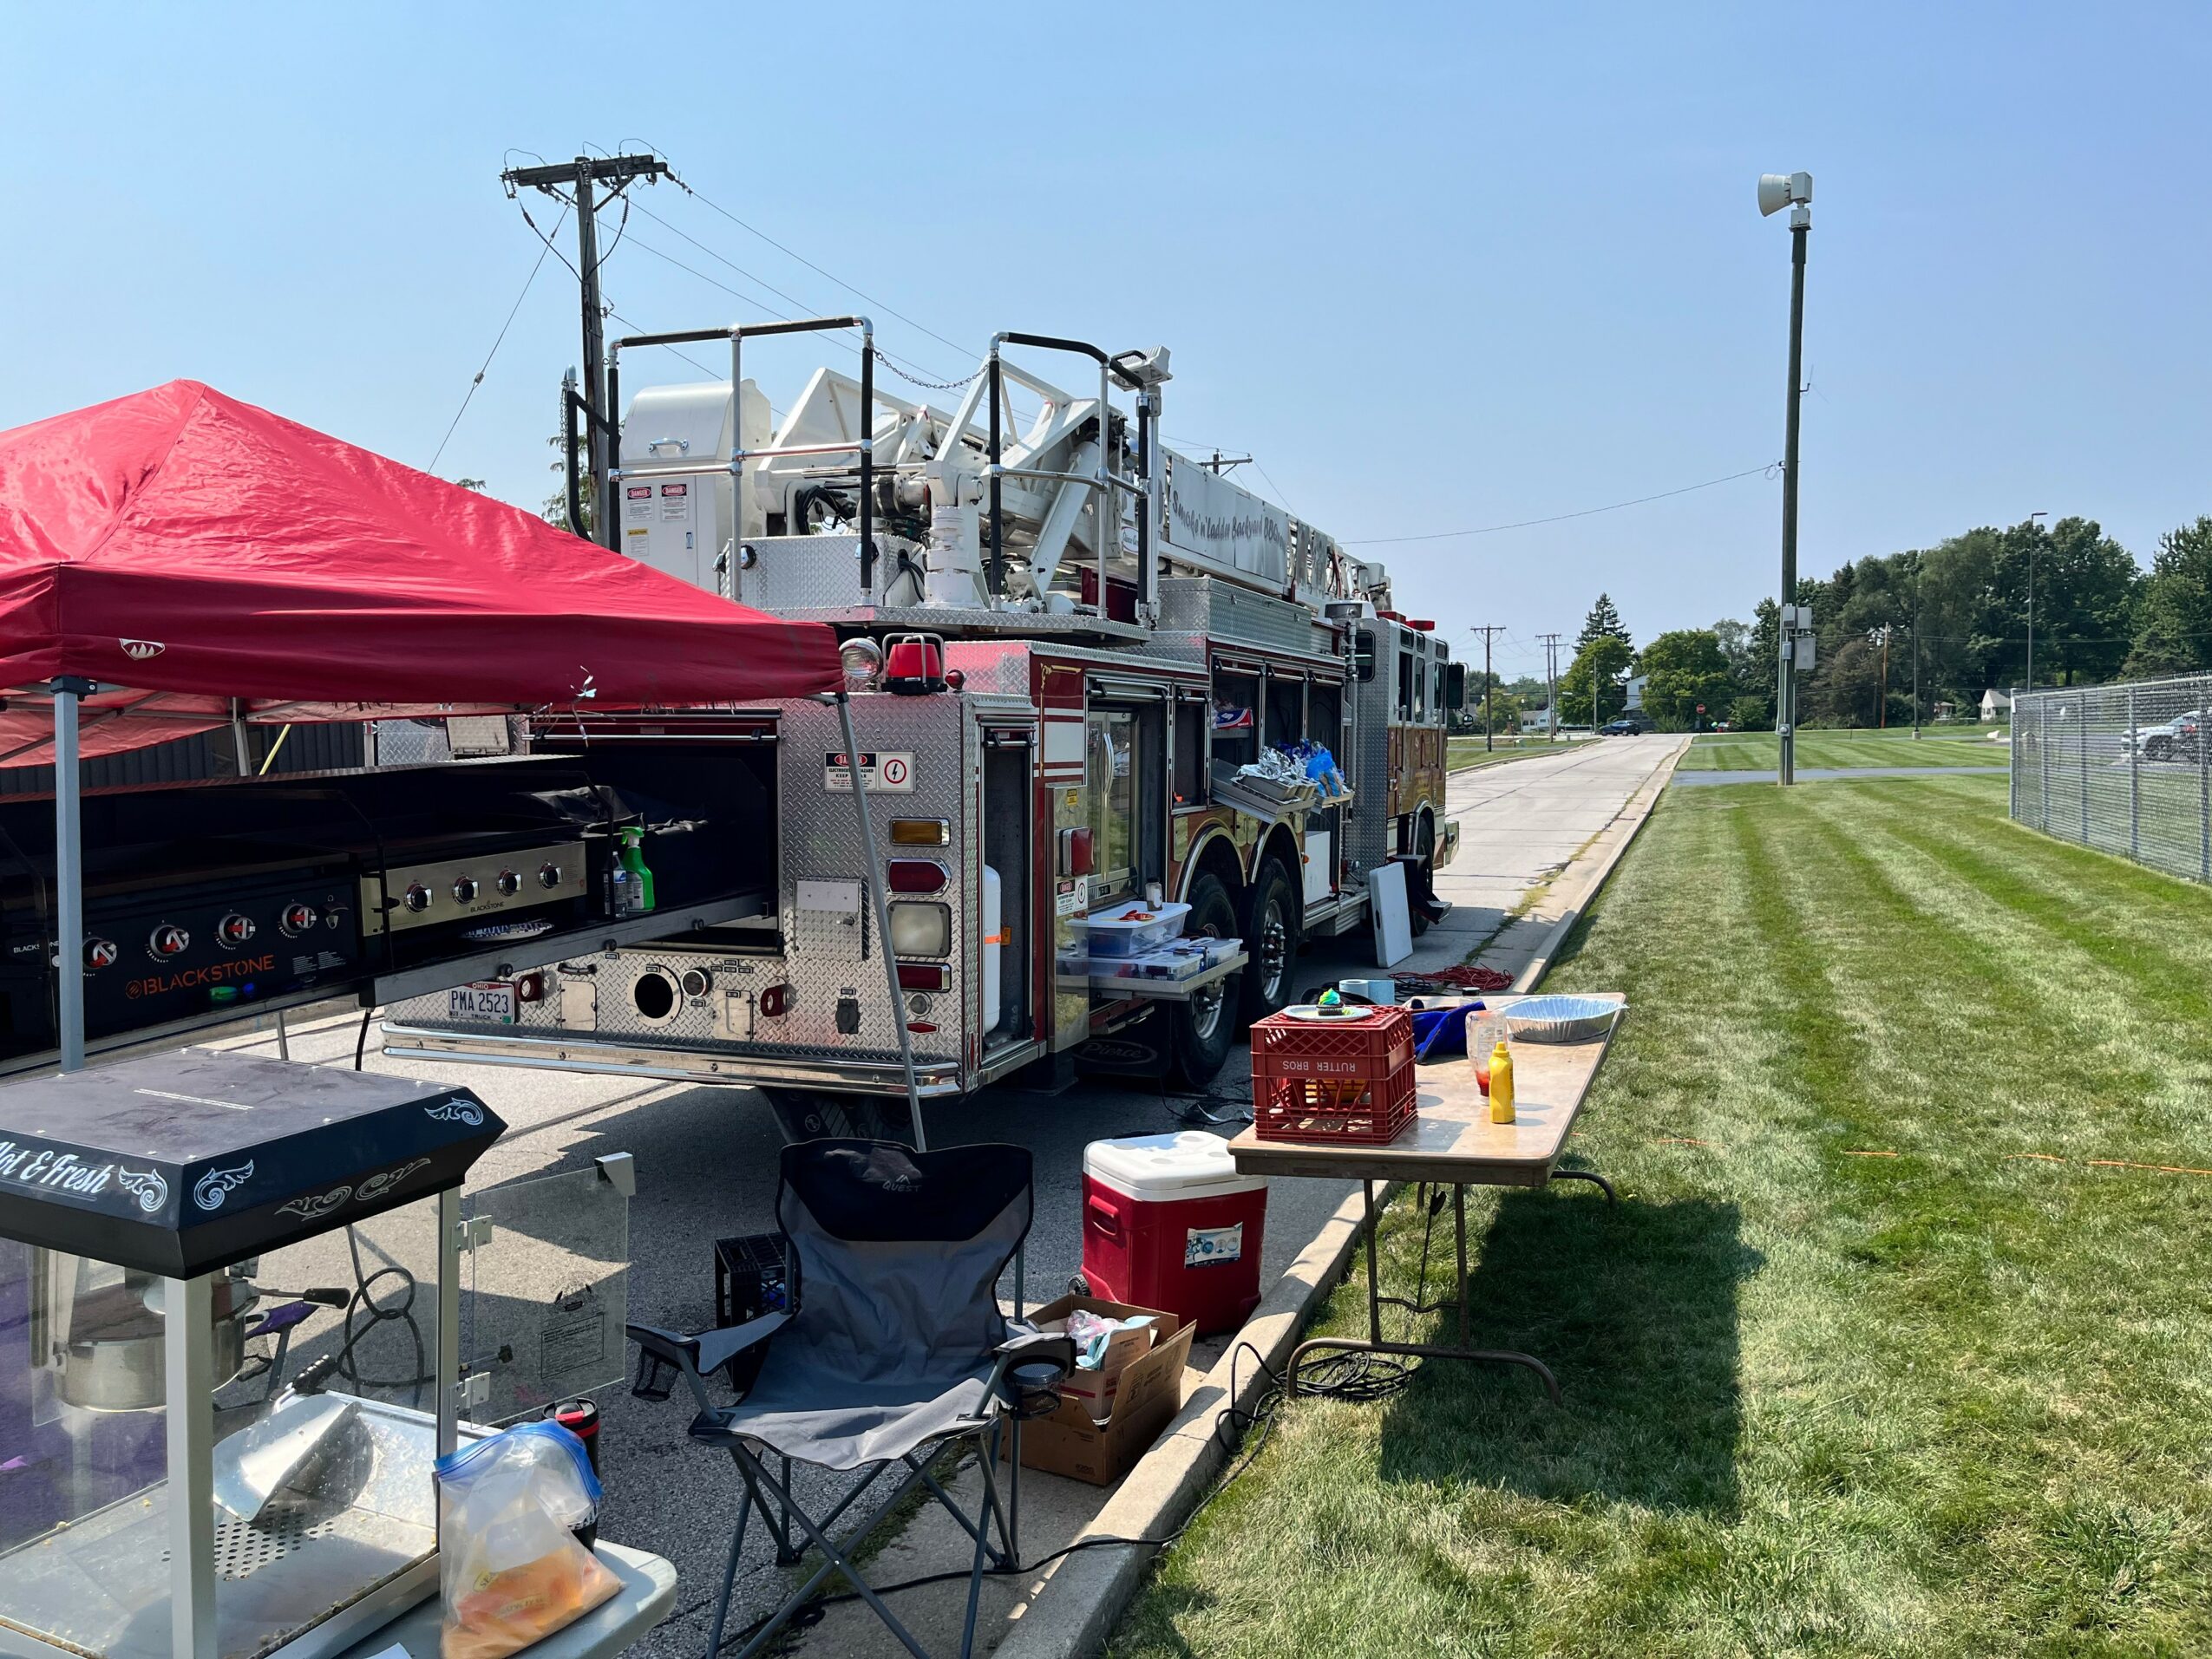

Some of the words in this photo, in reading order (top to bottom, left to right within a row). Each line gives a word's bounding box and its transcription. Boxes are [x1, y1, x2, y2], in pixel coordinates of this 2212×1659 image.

[631, 489, 649, 498] DANGER
[470, 902, 505, 913] BLACKSTONE
[142, 954, 275, 995] BLACKSTONE
[451, 990, 474, 1011] PMA
[478, 992, 508, 1014] 2523
[1279, 1060, 1309, 1071] BROS.
[1317, 1061, 1356, 1073] RUTTER
[38, 1153, 116, 1194] Fresh
[882, 1179, 922, 1193] QUEST
